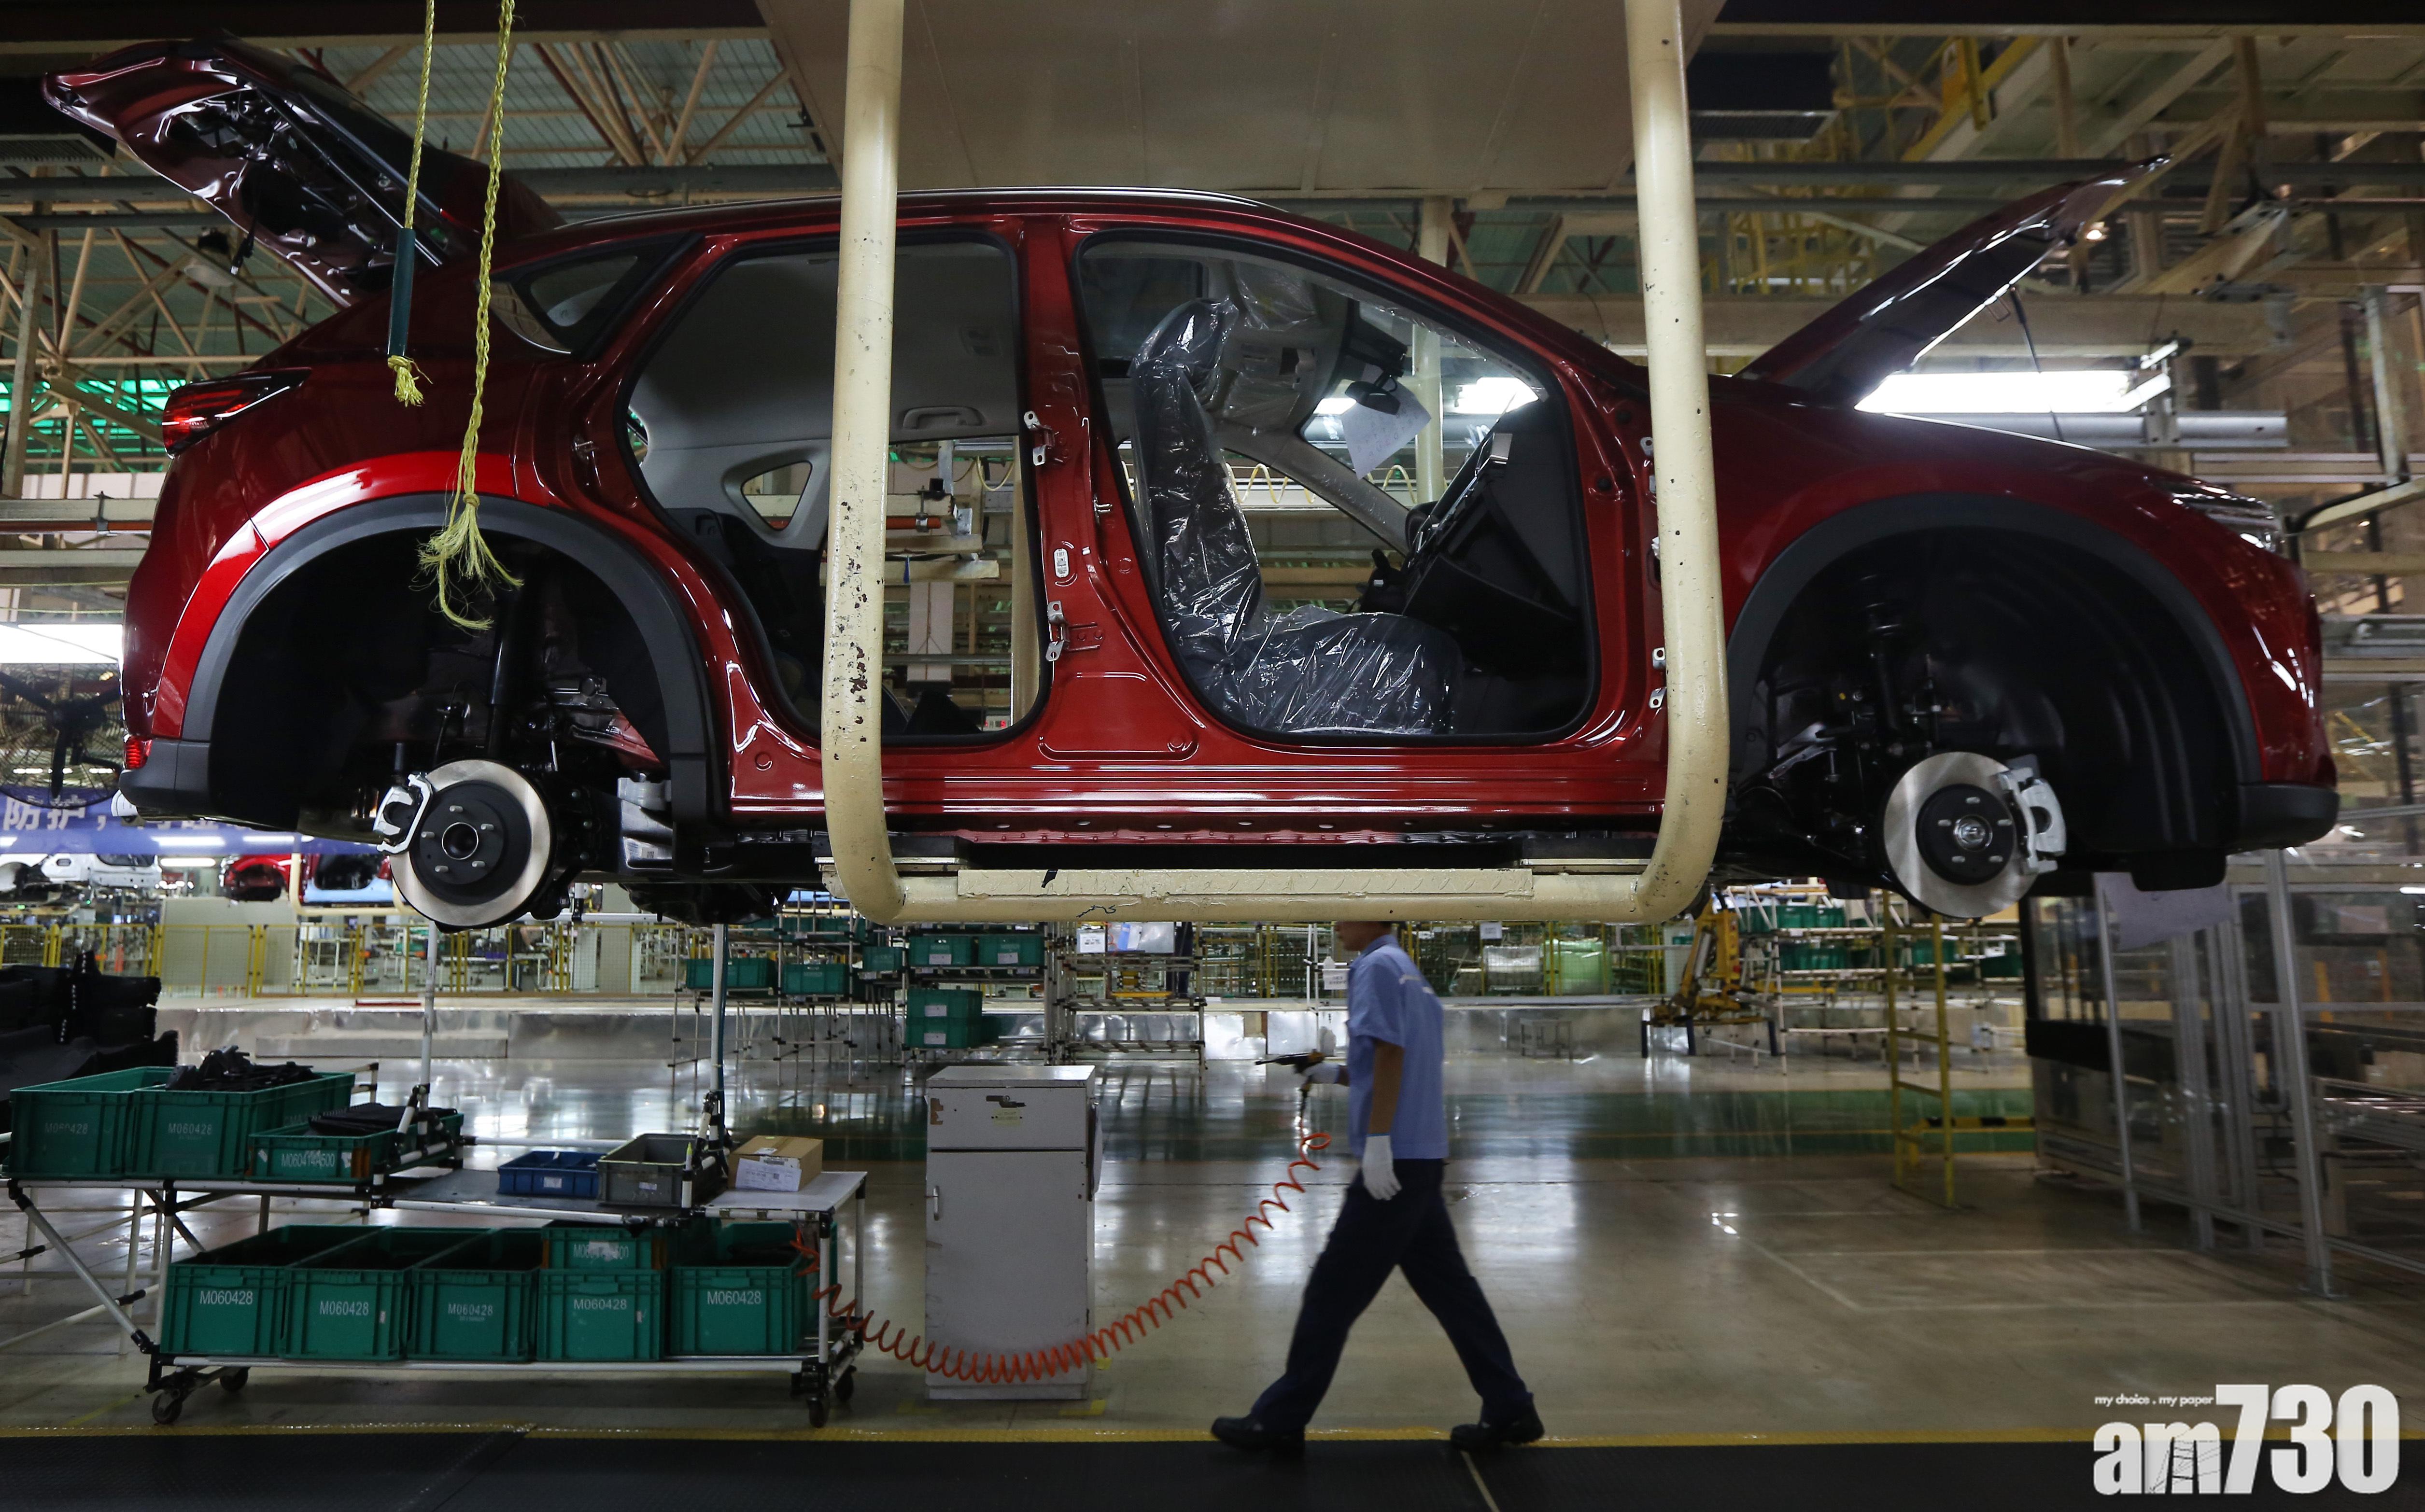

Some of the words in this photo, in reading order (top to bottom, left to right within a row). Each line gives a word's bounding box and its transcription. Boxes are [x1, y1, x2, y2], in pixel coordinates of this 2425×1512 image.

[168, 1122, 213, 1135] M060428
[200, 1290, 253, 1304] M060428
[707, 1290, 761, 1305] M060428
[320, 1301, 369, 1316] M060428
[448, 1303, 493, 1316] M060428
[574, 1299, 627, 1310] M060428
